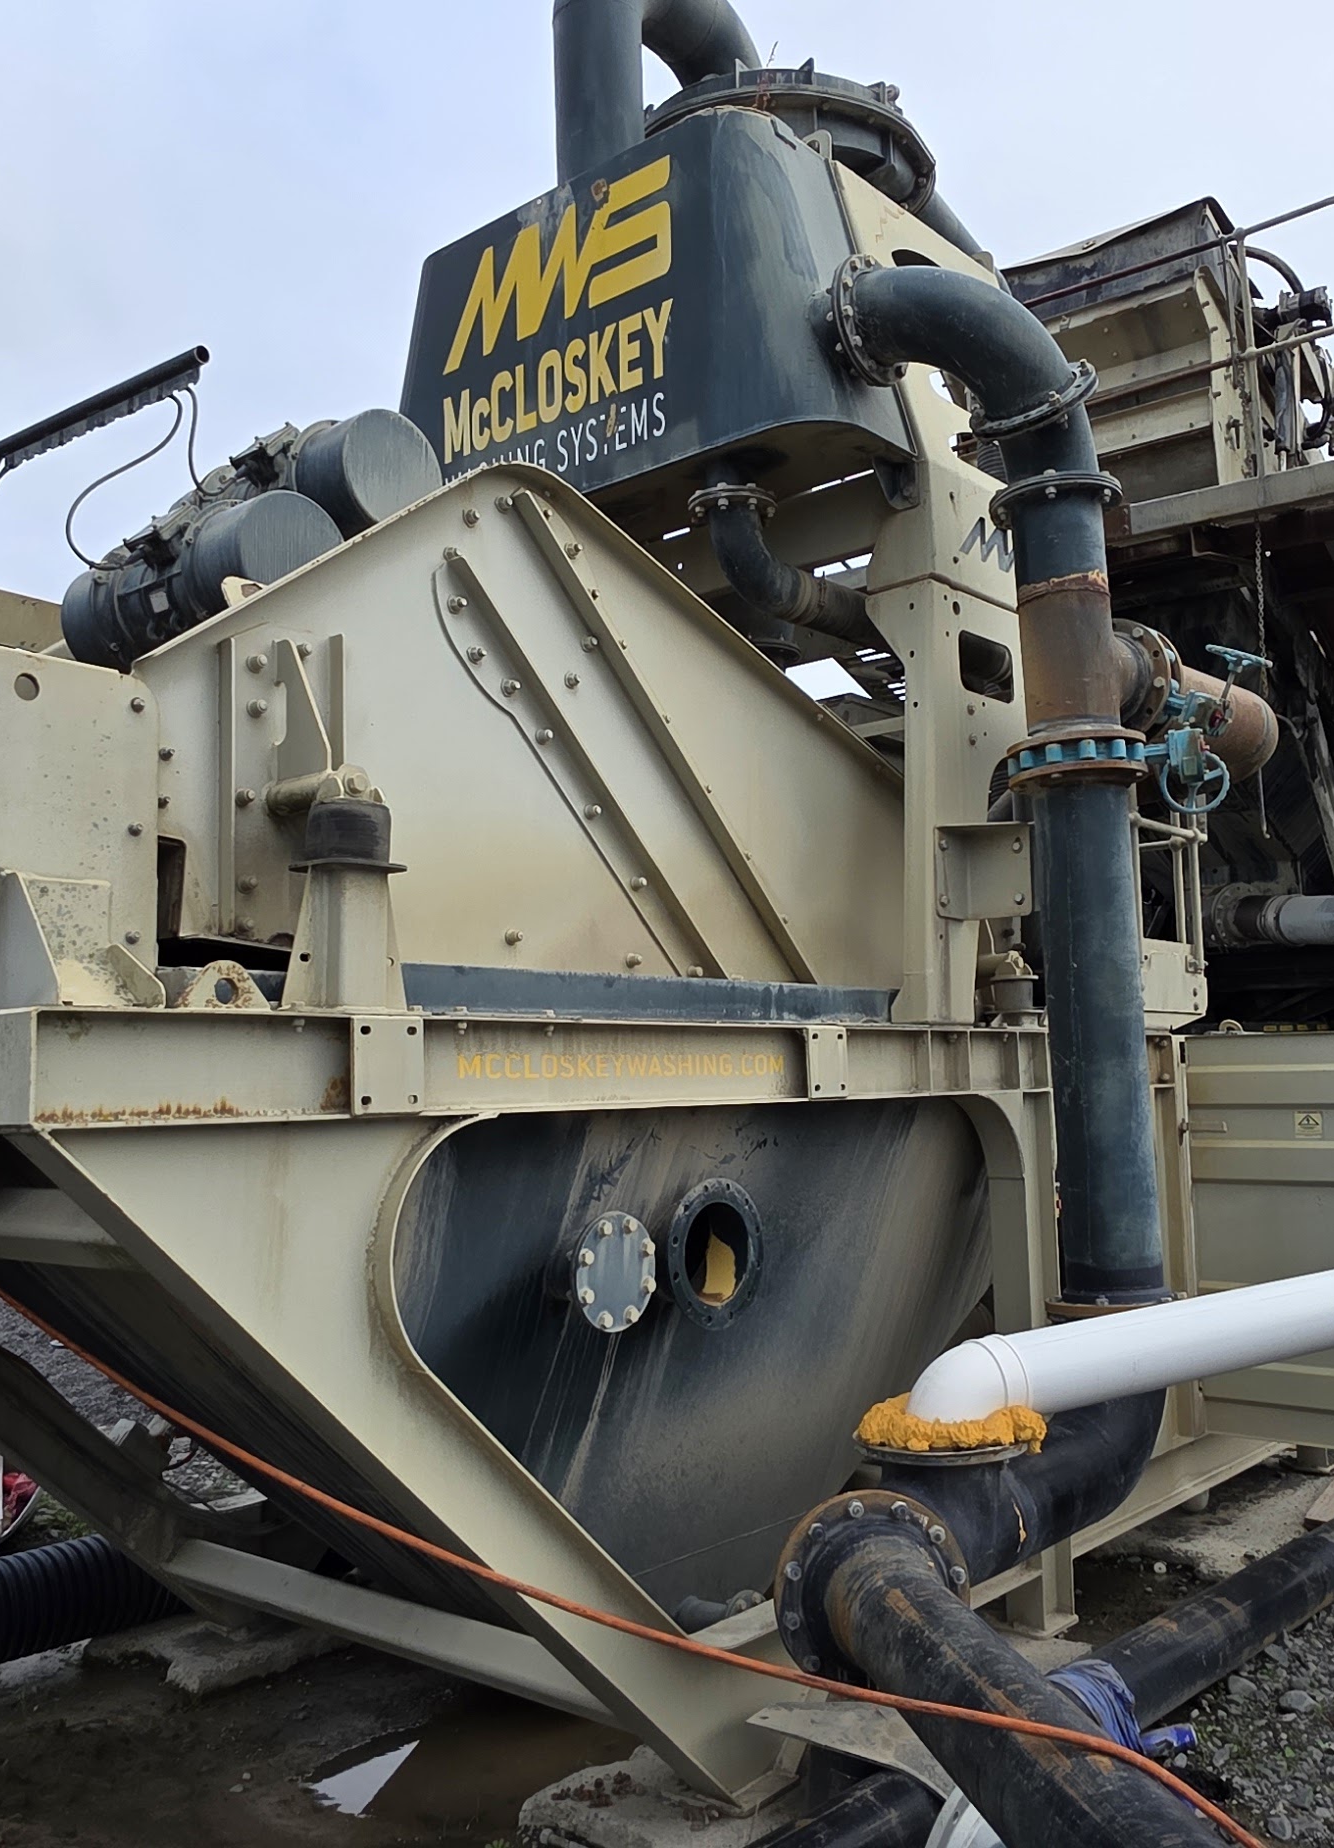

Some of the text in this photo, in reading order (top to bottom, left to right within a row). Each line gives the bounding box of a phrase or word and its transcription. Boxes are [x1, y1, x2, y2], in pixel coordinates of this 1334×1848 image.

[442, 154, 672, 376] MWS
[443, 298, 674, 464] McCLOSKEY
[457, 1053, 784, 1081] MCCLOSKEYWASHING.COM
